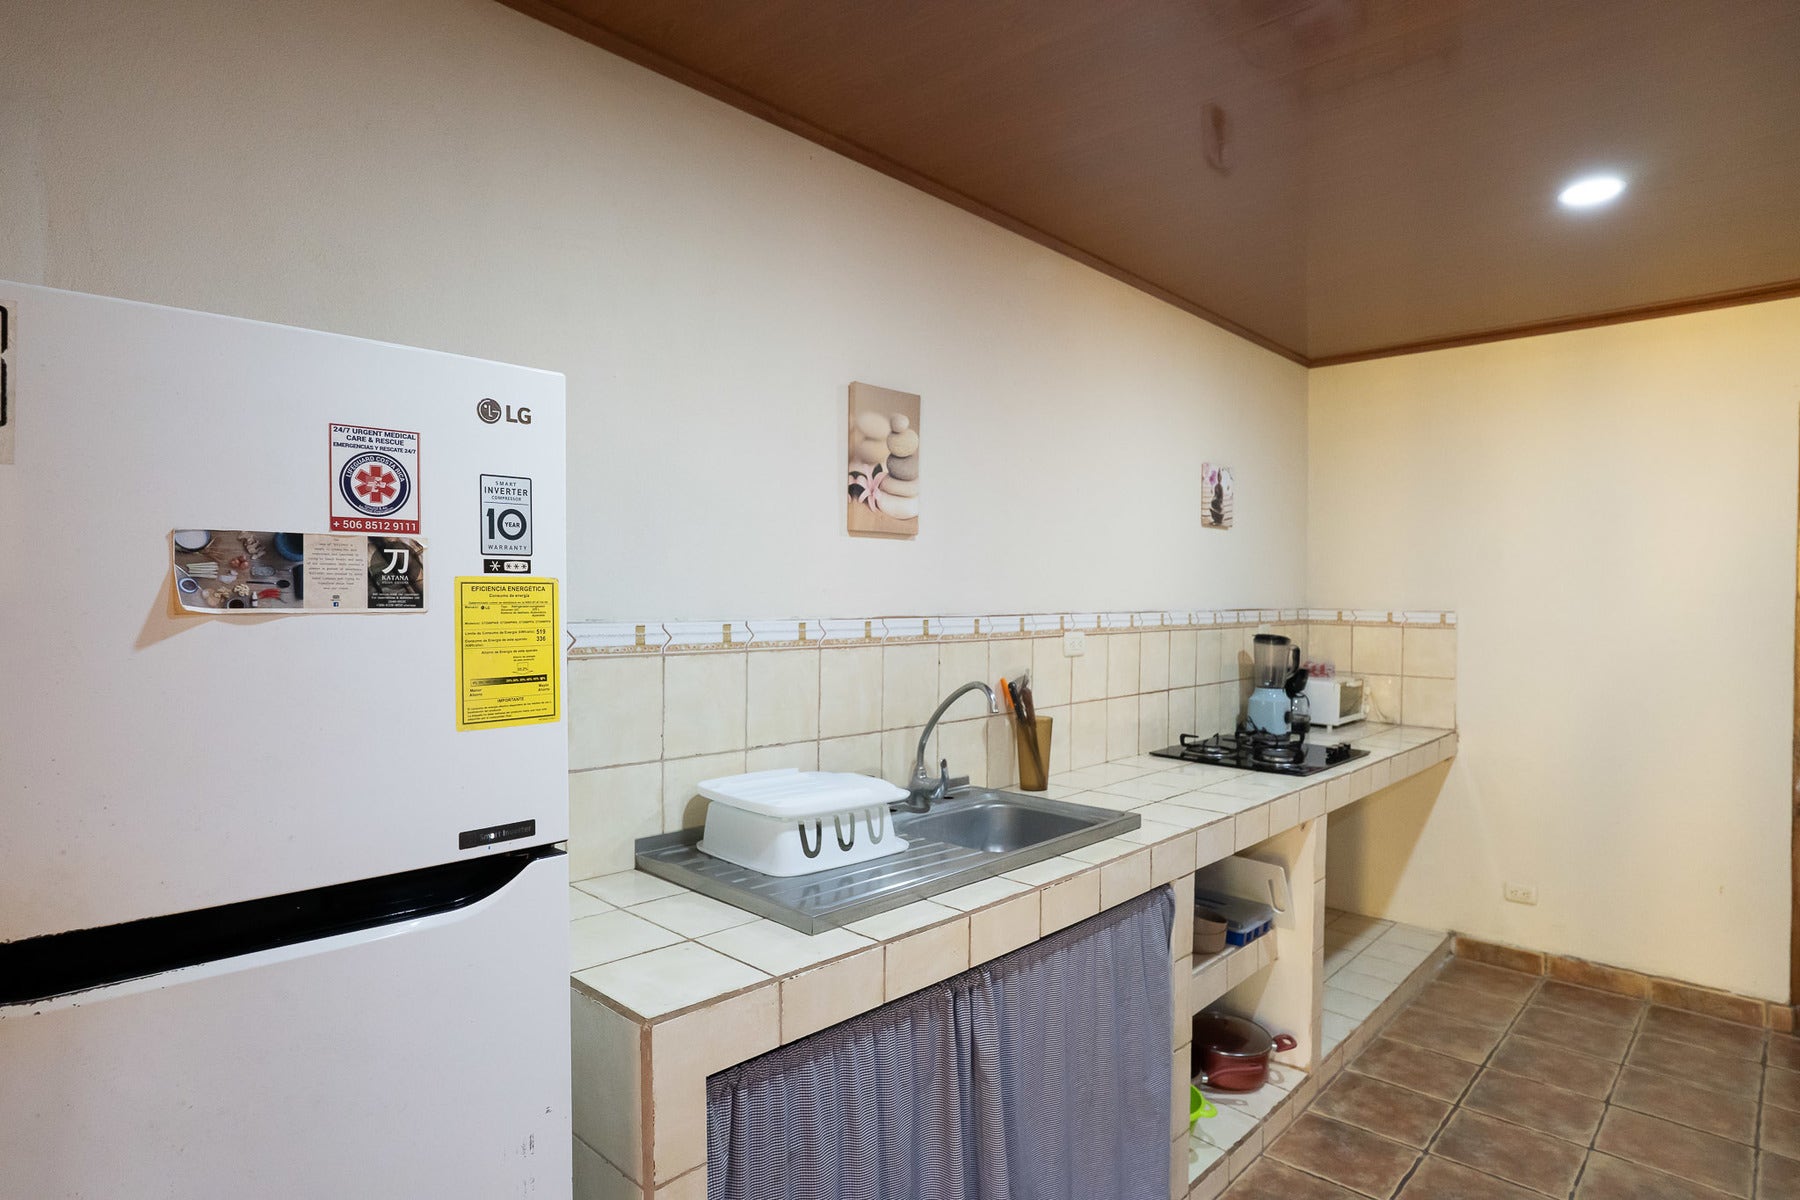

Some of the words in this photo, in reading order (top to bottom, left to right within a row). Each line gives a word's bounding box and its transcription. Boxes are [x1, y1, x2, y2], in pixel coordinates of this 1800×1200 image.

[506, 404, 532, 424] LG
[352, 427, 382, 437] URGENT
[384, 432, 416, 440] MEDICAL
[333, 442, 374, 450] EMERGENCIAS
[375, 438, 404, 446] RESCUE
[346, 455, 375, 478] LIFEGUARD
[376, 456, 396, 471] COSTA
[394, 467, 405, 482] RICA
[484, 486, 528, 496] INVERTER
[343, 520, 362, 529] 506
[365, 521, 390, 530] 8512
[393, 522, 416, 531] 9111
[486, 508, 527, 540] 10
[382, 549, 409, 574] 刀
